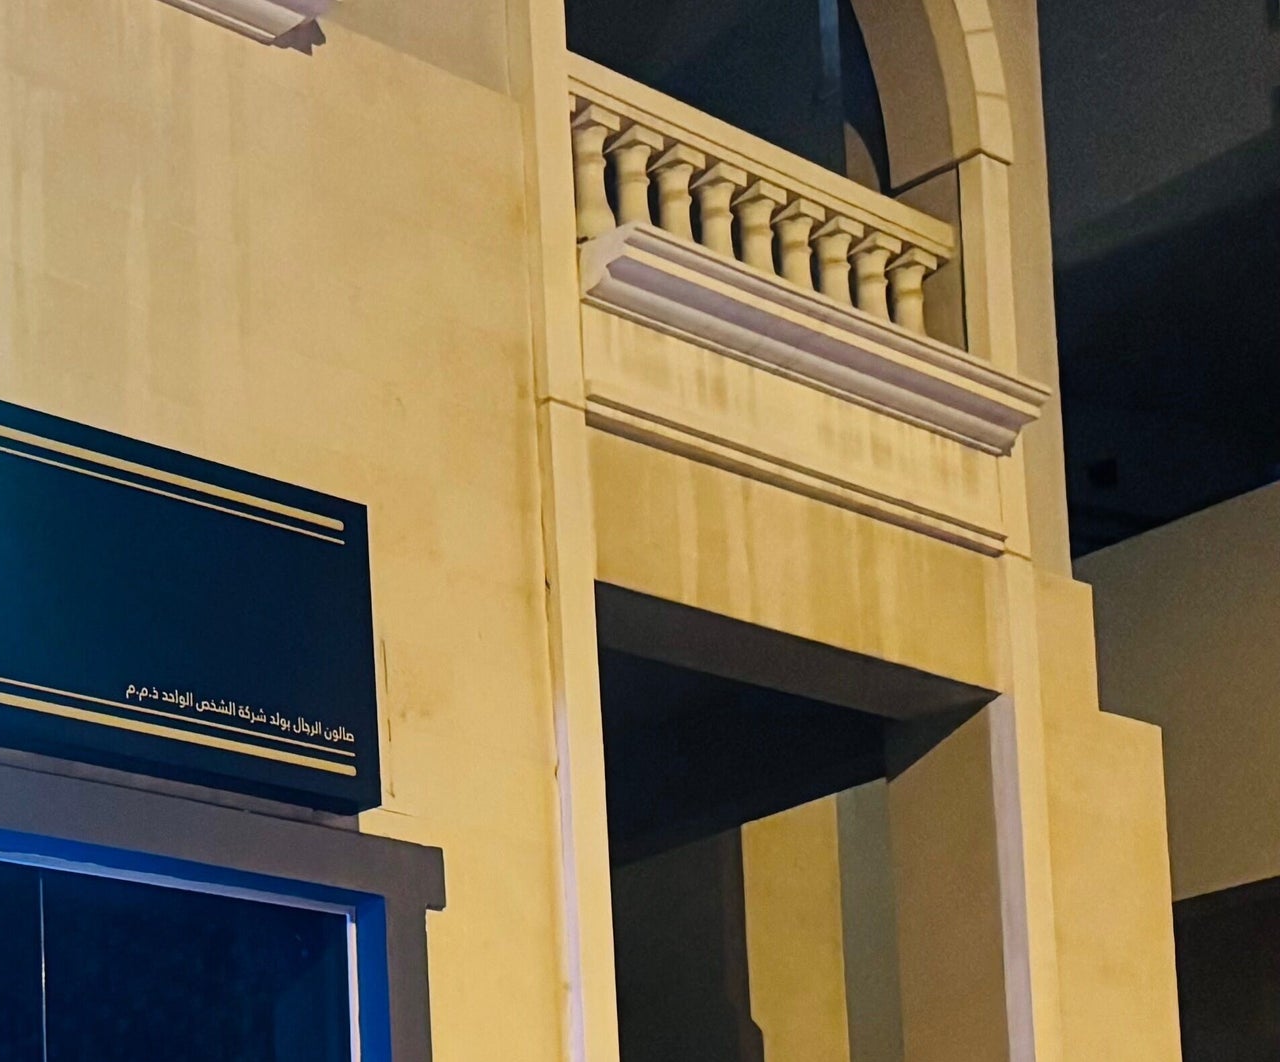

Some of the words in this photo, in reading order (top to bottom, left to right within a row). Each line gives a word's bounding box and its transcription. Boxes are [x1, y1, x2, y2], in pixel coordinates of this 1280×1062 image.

[161, 689, 193, 709] الواحد
[195, 699, 236, 717] الشخص
[238, 705, 267, 724] شركة
[269, 711, 291, 732] بولد
[293, 716, 322, 737] الرجال
[324, 725, 355, 743] صالون
